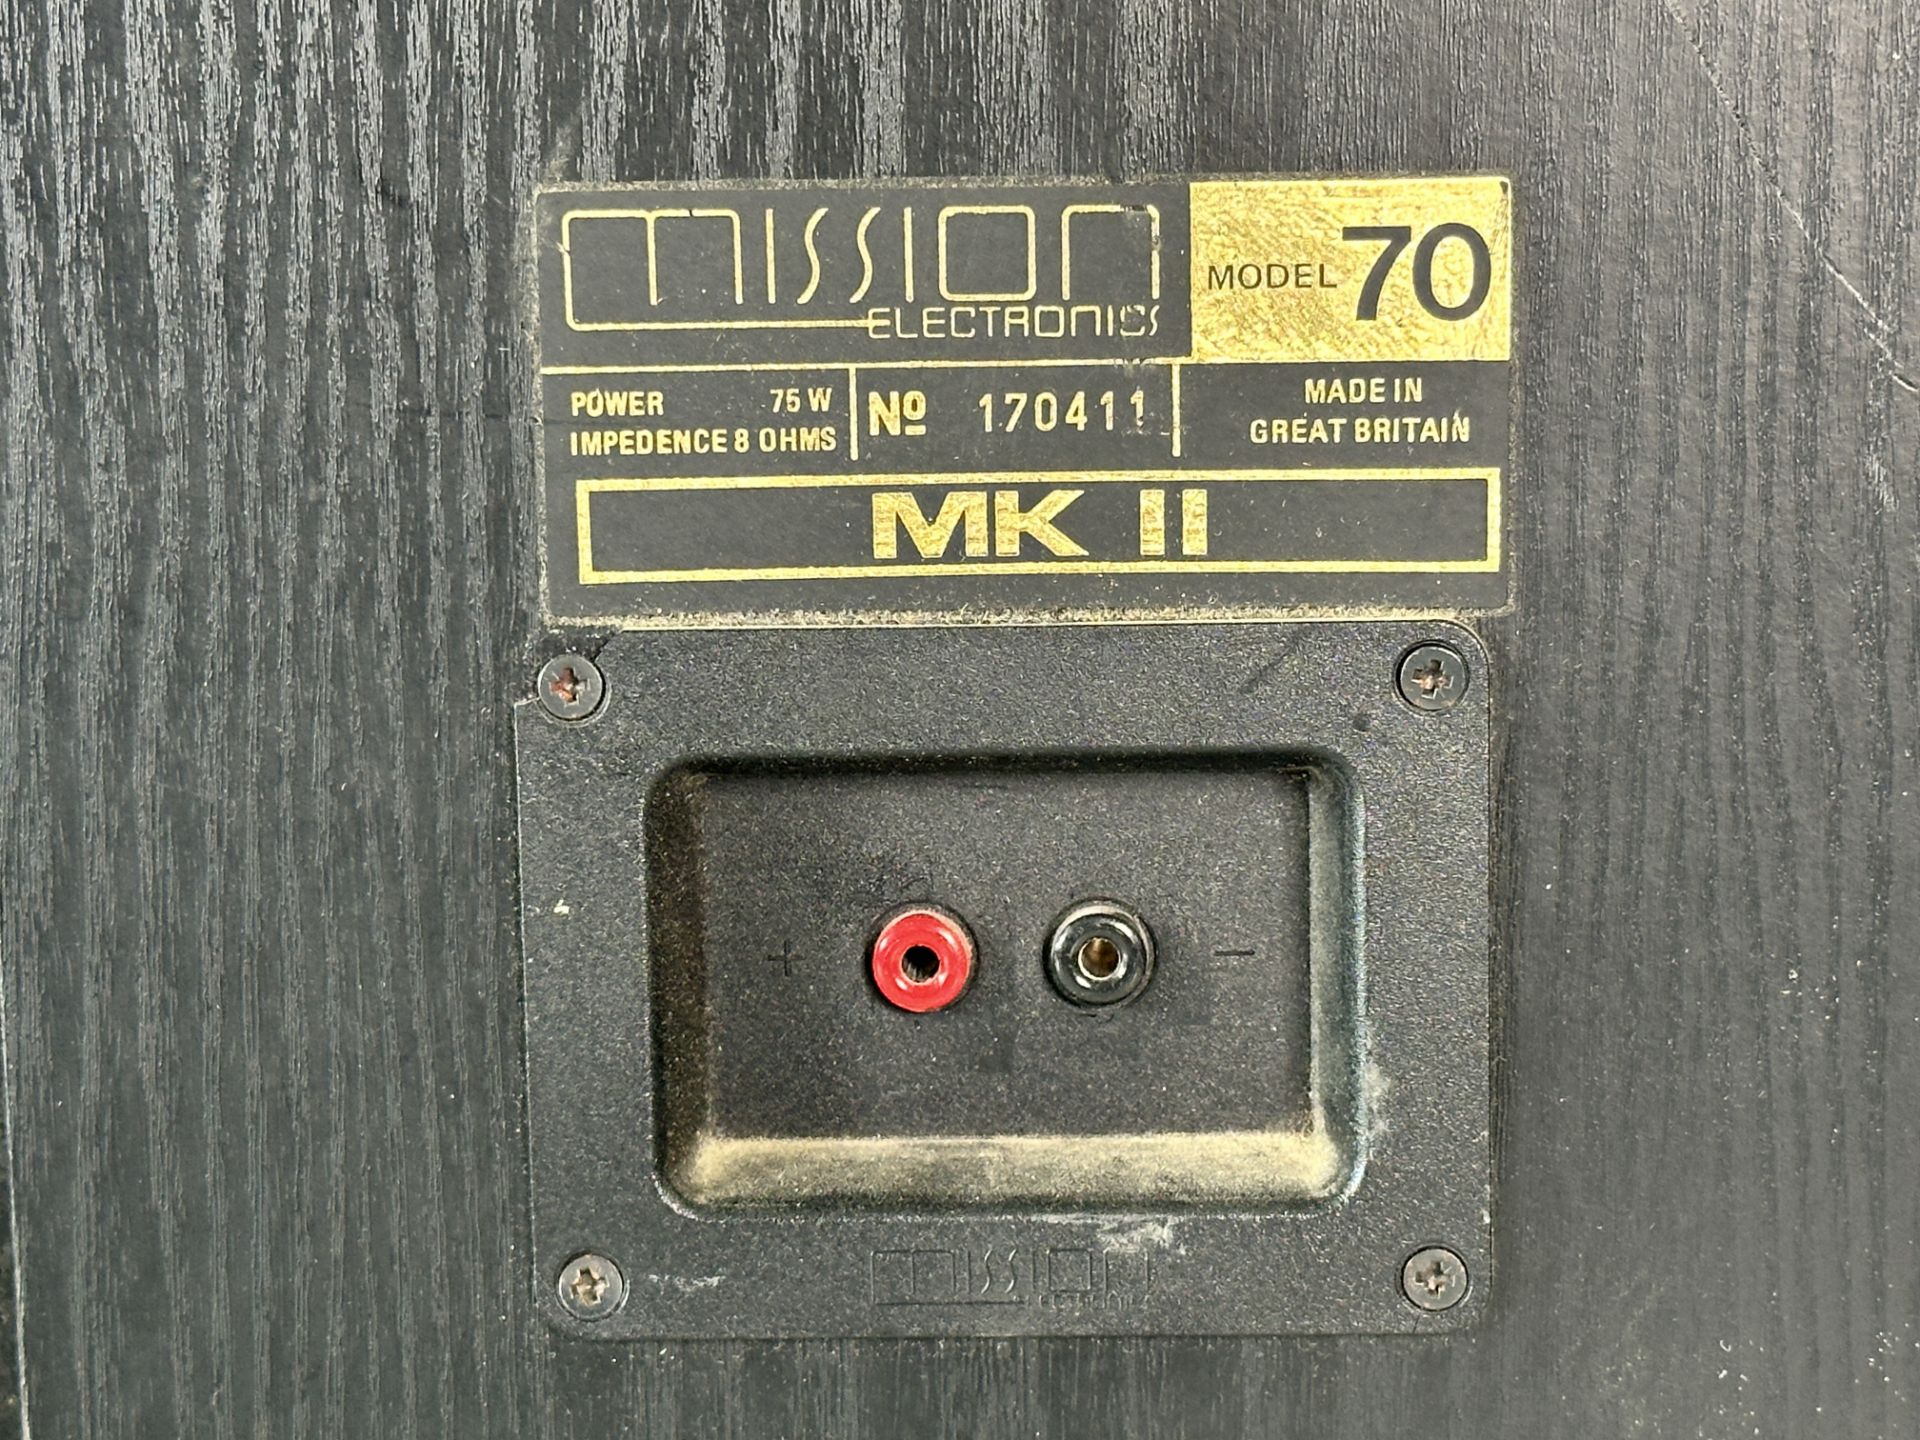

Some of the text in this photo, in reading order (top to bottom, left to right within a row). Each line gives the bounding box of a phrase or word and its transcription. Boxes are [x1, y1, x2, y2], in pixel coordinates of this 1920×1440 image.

[1207, 222, 1492, 321] MODEL 70
[570, 387, 832, 417] POWER 75 W
[1304, 377, 1423, 404] MADE IN
[978, 389, 1145, 433] 170411
[569, 426, 837, 456] IMPEDENCE 8 OHMS
[1249, 415, 1471, 444] GREAT BRITAIN
[871, 488, 1208, 560] MK II
